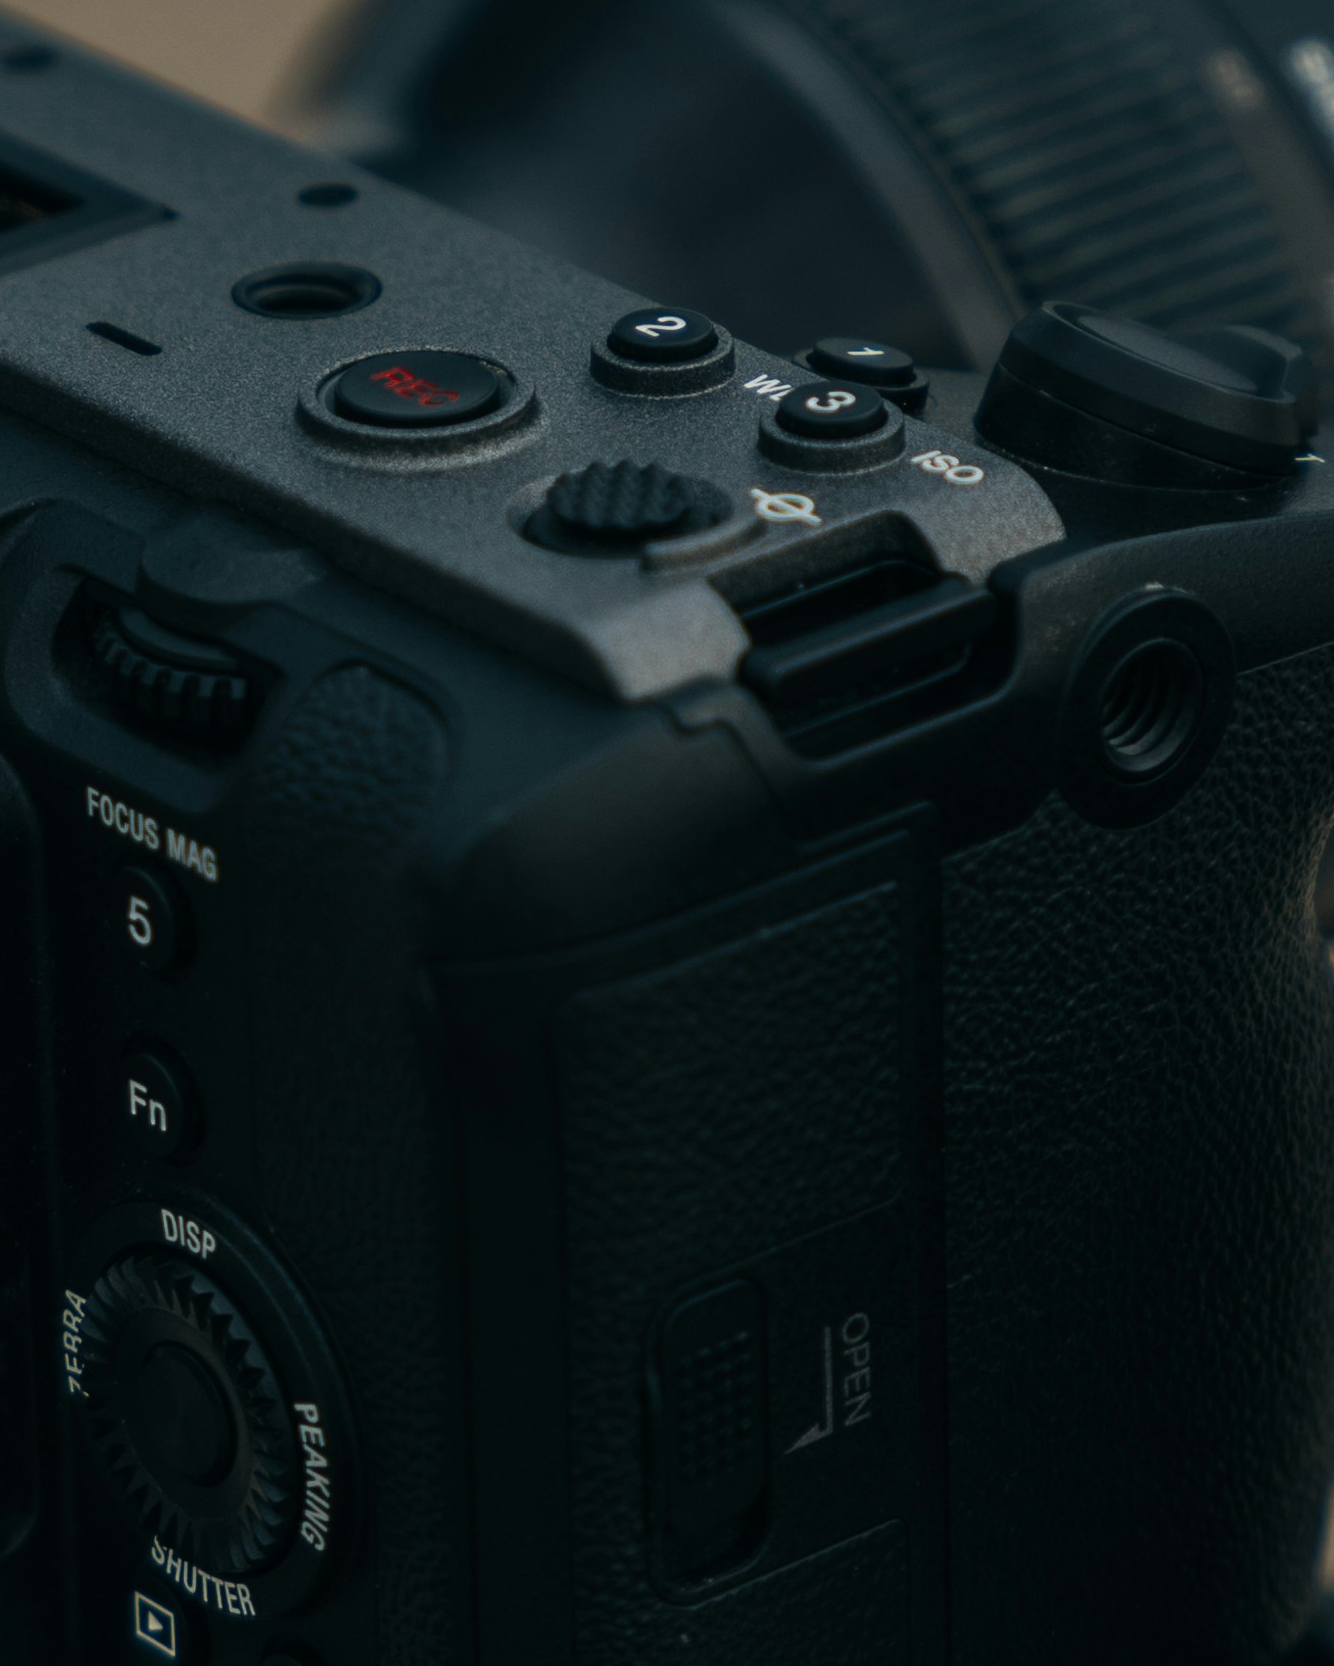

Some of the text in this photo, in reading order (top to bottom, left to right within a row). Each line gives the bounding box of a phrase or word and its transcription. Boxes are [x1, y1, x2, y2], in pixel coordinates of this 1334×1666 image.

[634, 315, 687, 337] 2
[369, 365, 460, 408] REC
[743, 372, 795, 402] W
[805, 390, 857, 414] 3
[910, 449, 985, 485] ISO
[85, 785, 220, 884] FOCUS MAG
[127, 894, 154, 947] 5
[126, 1078, 168, 1132] Fn
[159, 1207, 217, 1260] DISP
[843, 1312, 872, 1427] OPEN
[292, 1400, 332, 1553] PEAKING
[150, 1534, 257, 1618] SHUTTER
